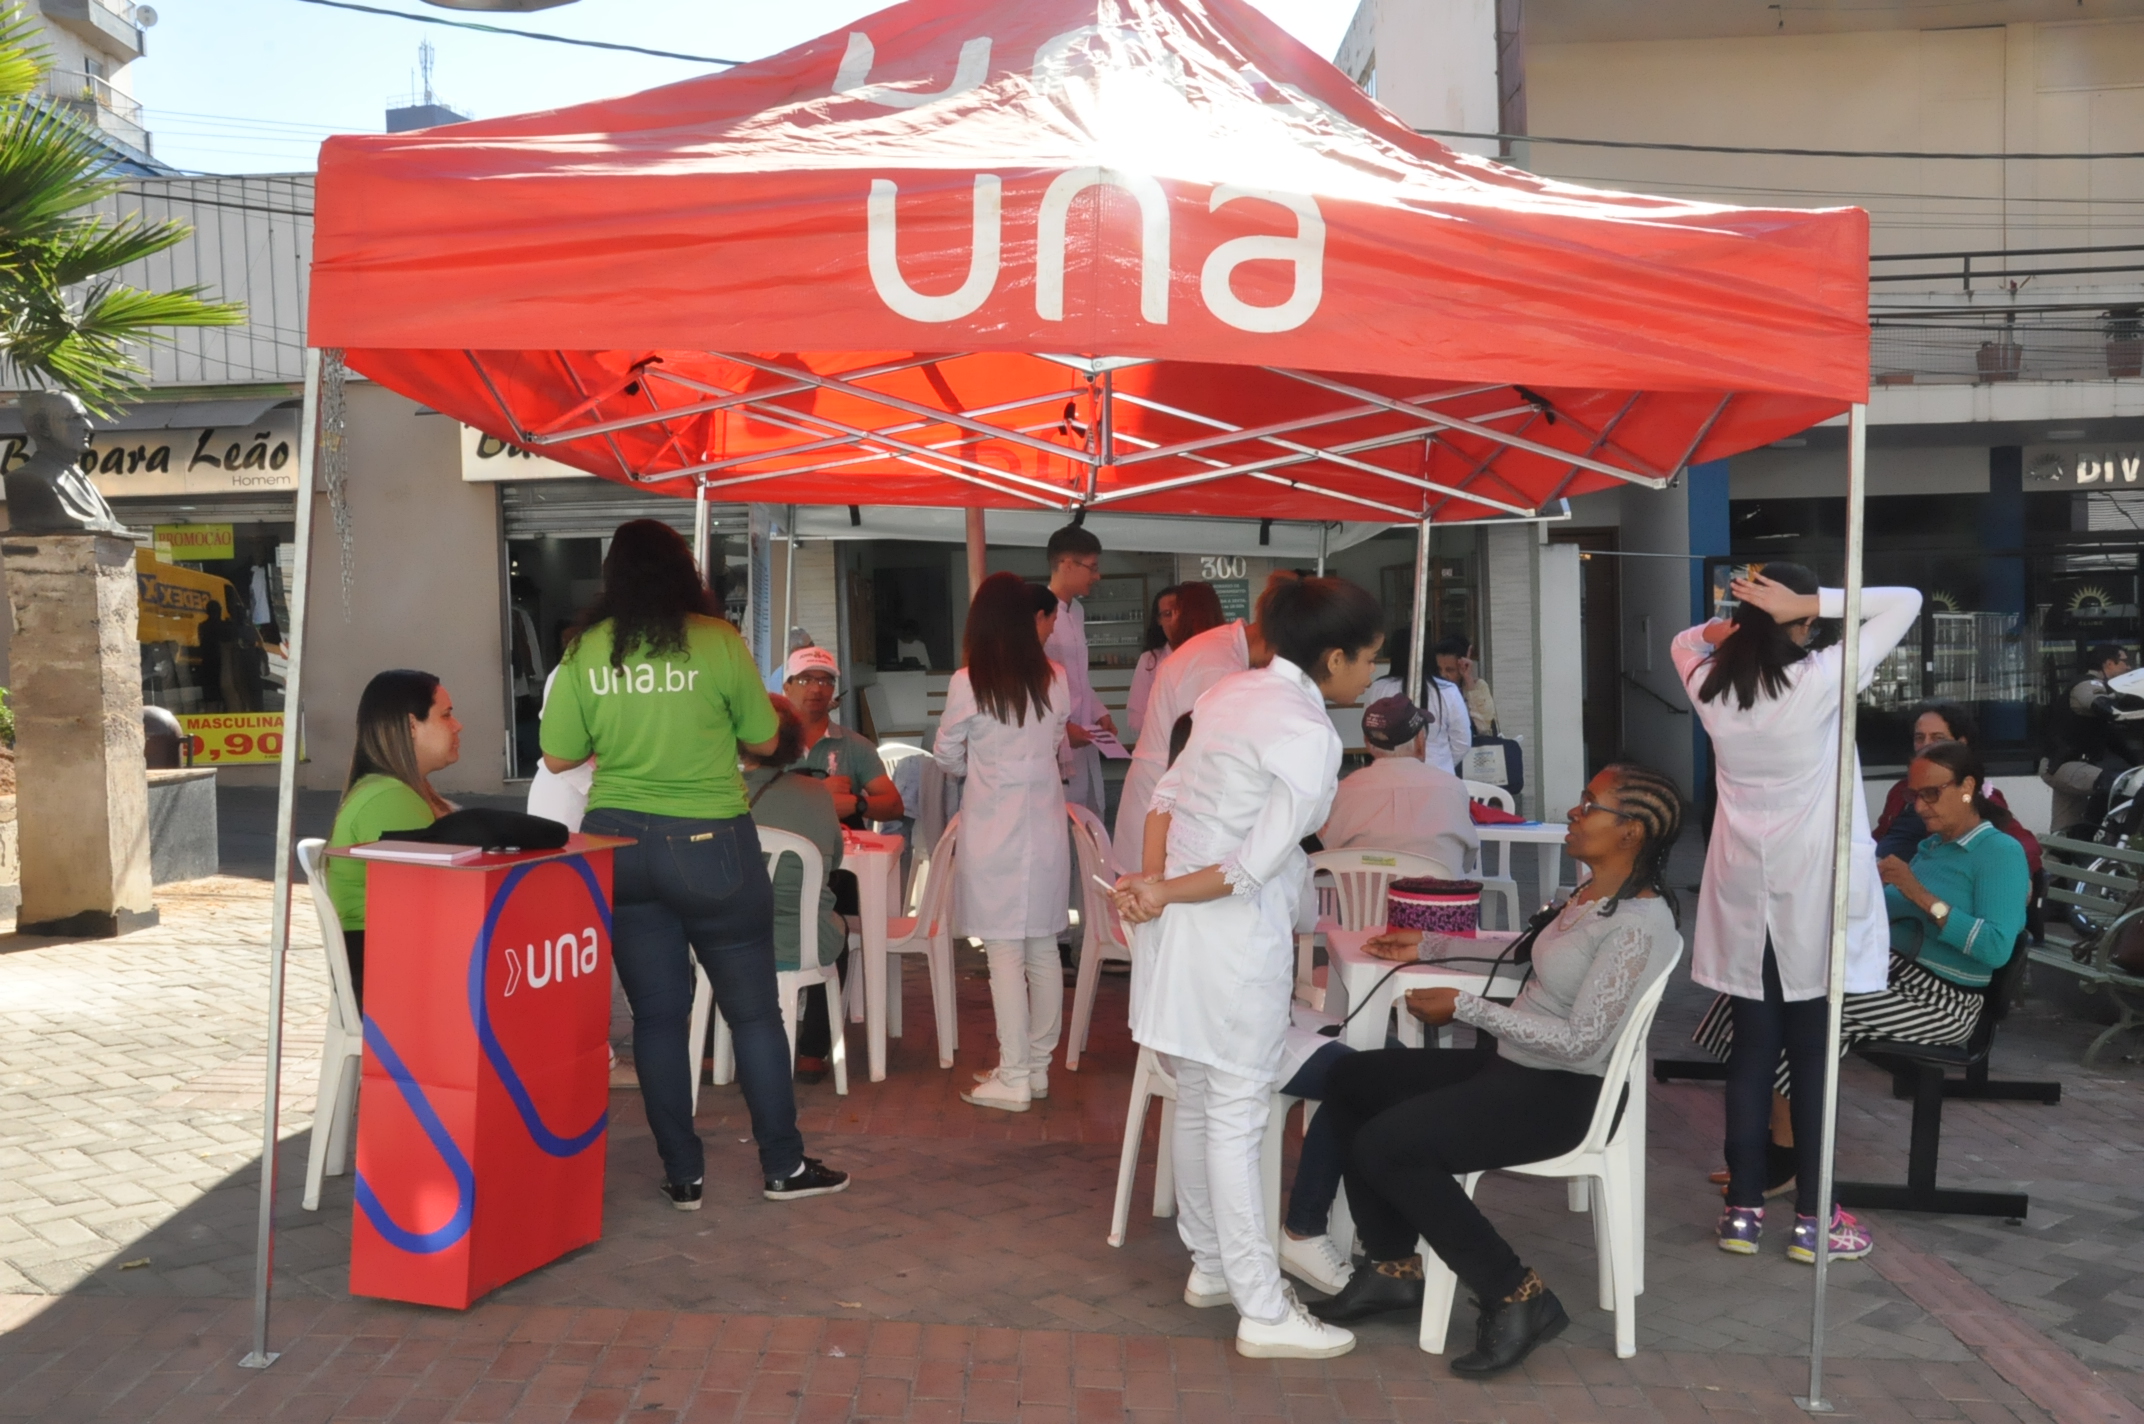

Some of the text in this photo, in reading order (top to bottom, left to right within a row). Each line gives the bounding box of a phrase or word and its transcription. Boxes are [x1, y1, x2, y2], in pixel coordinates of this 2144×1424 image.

[867, 166, 1326, 334] una
[188, 429, 289, 472] Leão
[232, 475, 291, 486] Homem
[157, 529, 232, 549] PROMOÇÃO
[1200, 556, 1247, 579] 300
[588, 661, 699, 695] una.br
[187, 716, 285, 730] MASCULINA
[526, 926, 598, 989] una
